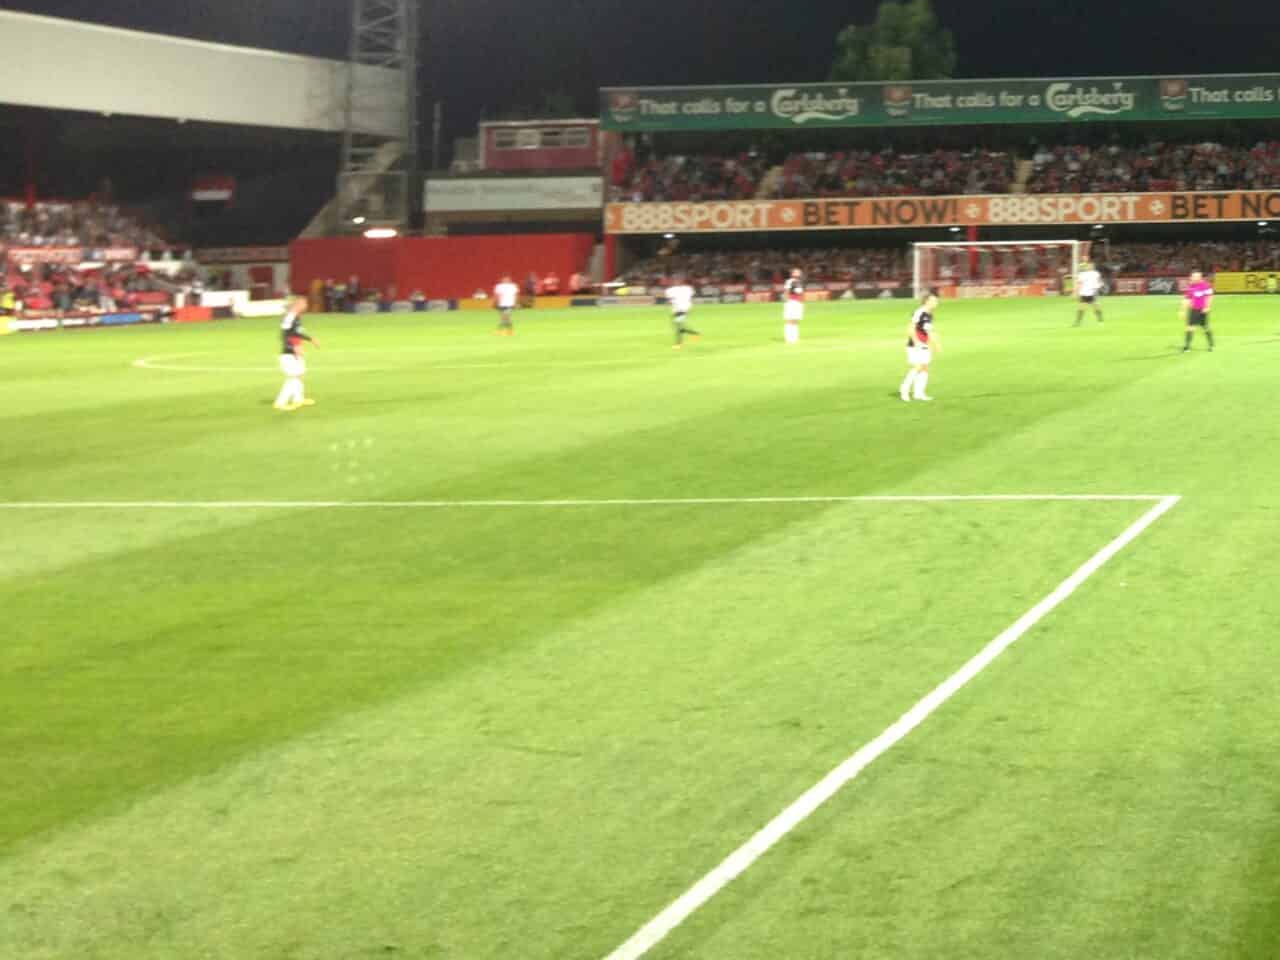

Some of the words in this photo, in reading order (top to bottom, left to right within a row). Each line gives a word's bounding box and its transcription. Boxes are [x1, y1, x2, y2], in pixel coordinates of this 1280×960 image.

[639, 98, 678, 114] That
[682, 98, 720, 114] calls
[725, 97, 750, 113] for
[753, 101, 766, 113] a
[770, 88, 859, 123] Carlsberg
[912, 93, 951, 109] That
[956, 93, 995, 108] calls
[999, 91, 1024, 107] for
[1028, 95, 1040, 106] a
[1045, 83, 1134, 117] Carlsberg
[1188, 87, 1229, 104] That
[1233, 87, 1274, 103] calls
[623, 203, 774, 230] 888SPORT
[803, 201, 860, 226] BET
[872, 199, 958, 225] NOW!
[988, 197, 1141, 223] 888SPORT
[1171, 194, 1229, 219] BET
